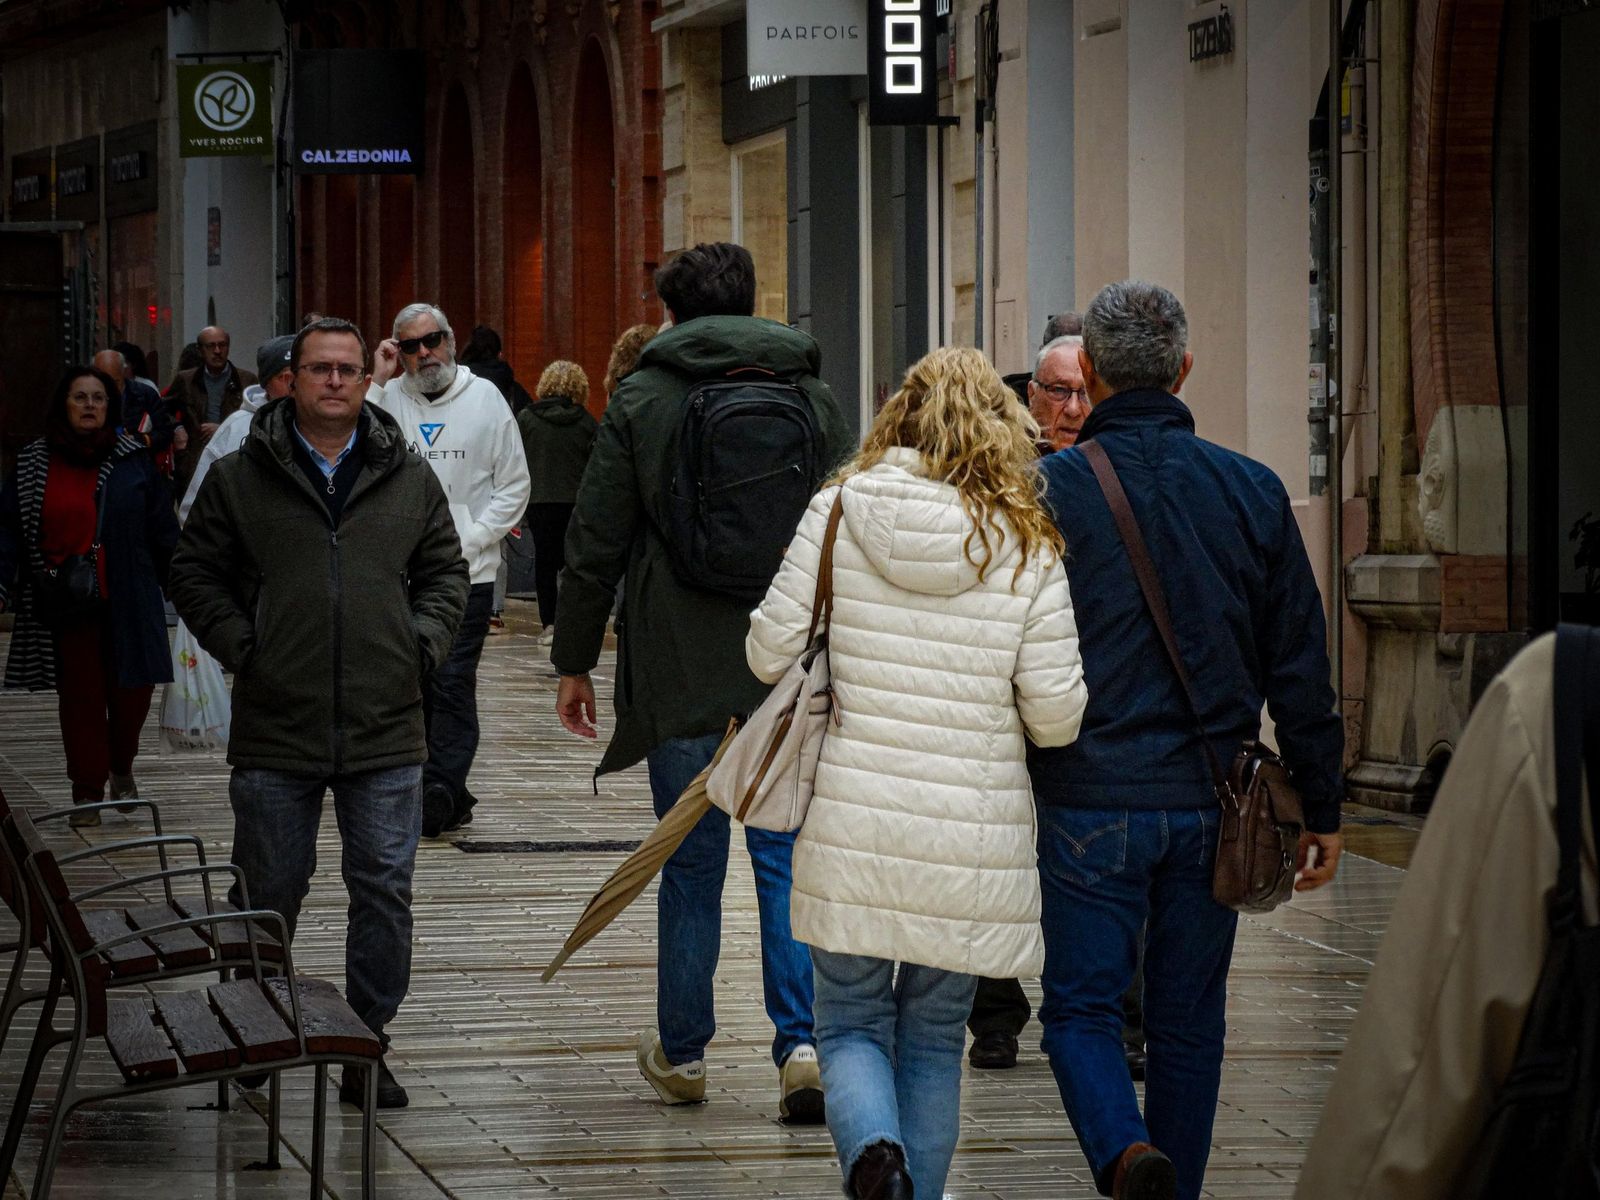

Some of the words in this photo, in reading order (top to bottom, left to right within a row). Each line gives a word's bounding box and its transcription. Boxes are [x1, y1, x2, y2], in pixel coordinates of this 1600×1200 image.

[767, 26, 858, 40] PARFOIS
[190, 138, 217, 147] YVES
[219, 136, 264, 146] ROCHER
[301, 149, 412, 164] CALZEDONIA
